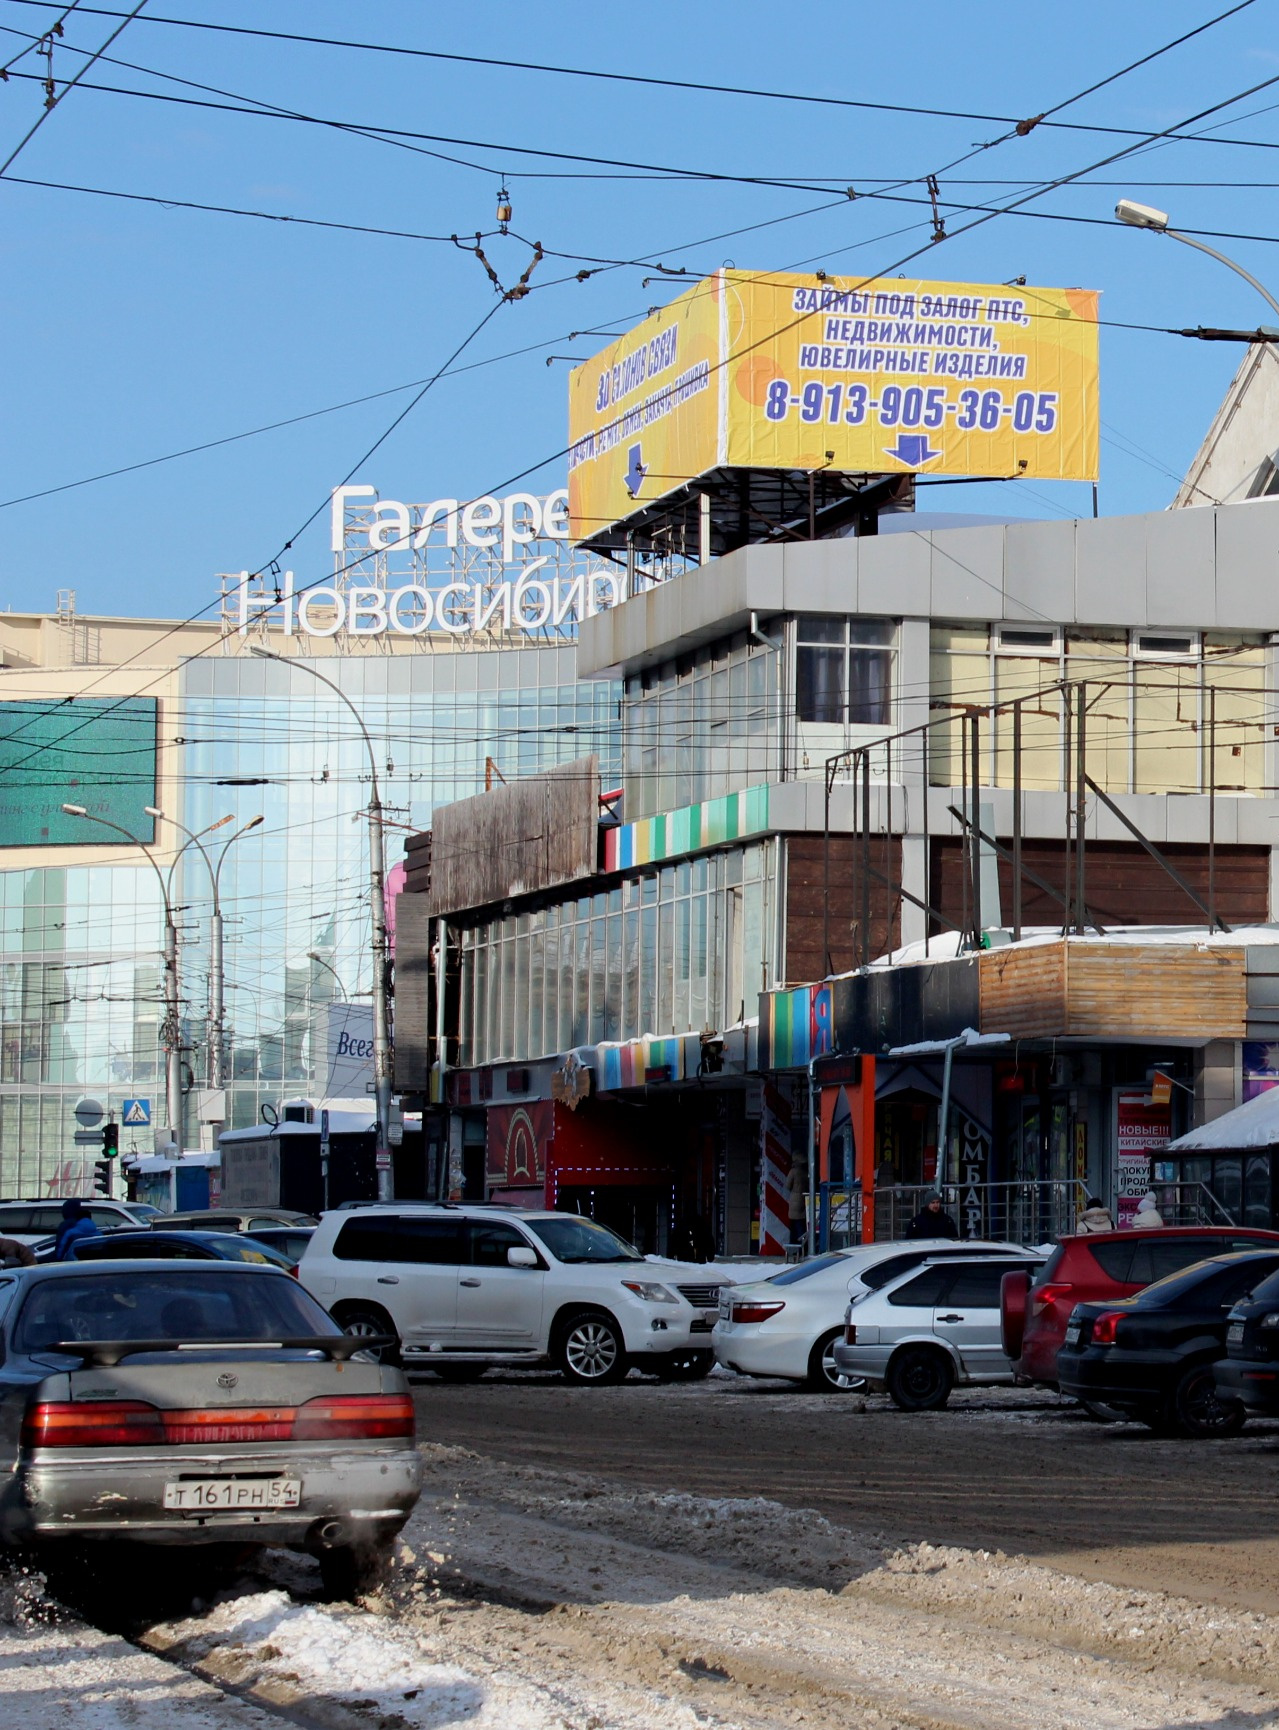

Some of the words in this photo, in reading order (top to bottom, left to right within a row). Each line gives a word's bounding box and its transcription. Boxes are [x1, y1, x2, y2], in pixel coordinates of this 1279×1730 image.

[794, 285, 868, 313] ЗАЙМЫ
[875, 294, 915, 318] ПОД
[920, 297, 982, 319] ЗАЛОГ
[988, 299, 1030, 325] ПТС,
[826, 319, 998, 351] НЕДВИЖИМОСТИ,
[596, 372, 610, 412] 30
[648, 323, 679, 378] СВЯЗИ
[800, 346, 930, 374] ЮВЕЛИРНЫЕ
[934, 353, 1026, 379] ИЗДЕЛИЯ
[766, 380, 1057, 432] 8-913-905-36-05
[331, 485, 568, 563] Галере
[240, 556, 632, 636] Новосибир
[337, 1031, 374, 1058] Всег
[1119, 1125, 1169, 1135] НОВЫЕ!!!
[1120, 1138, 1168, 1147] КИТАЙСКИЕ
[962, 1120, 985, 1238] ОМБАР
